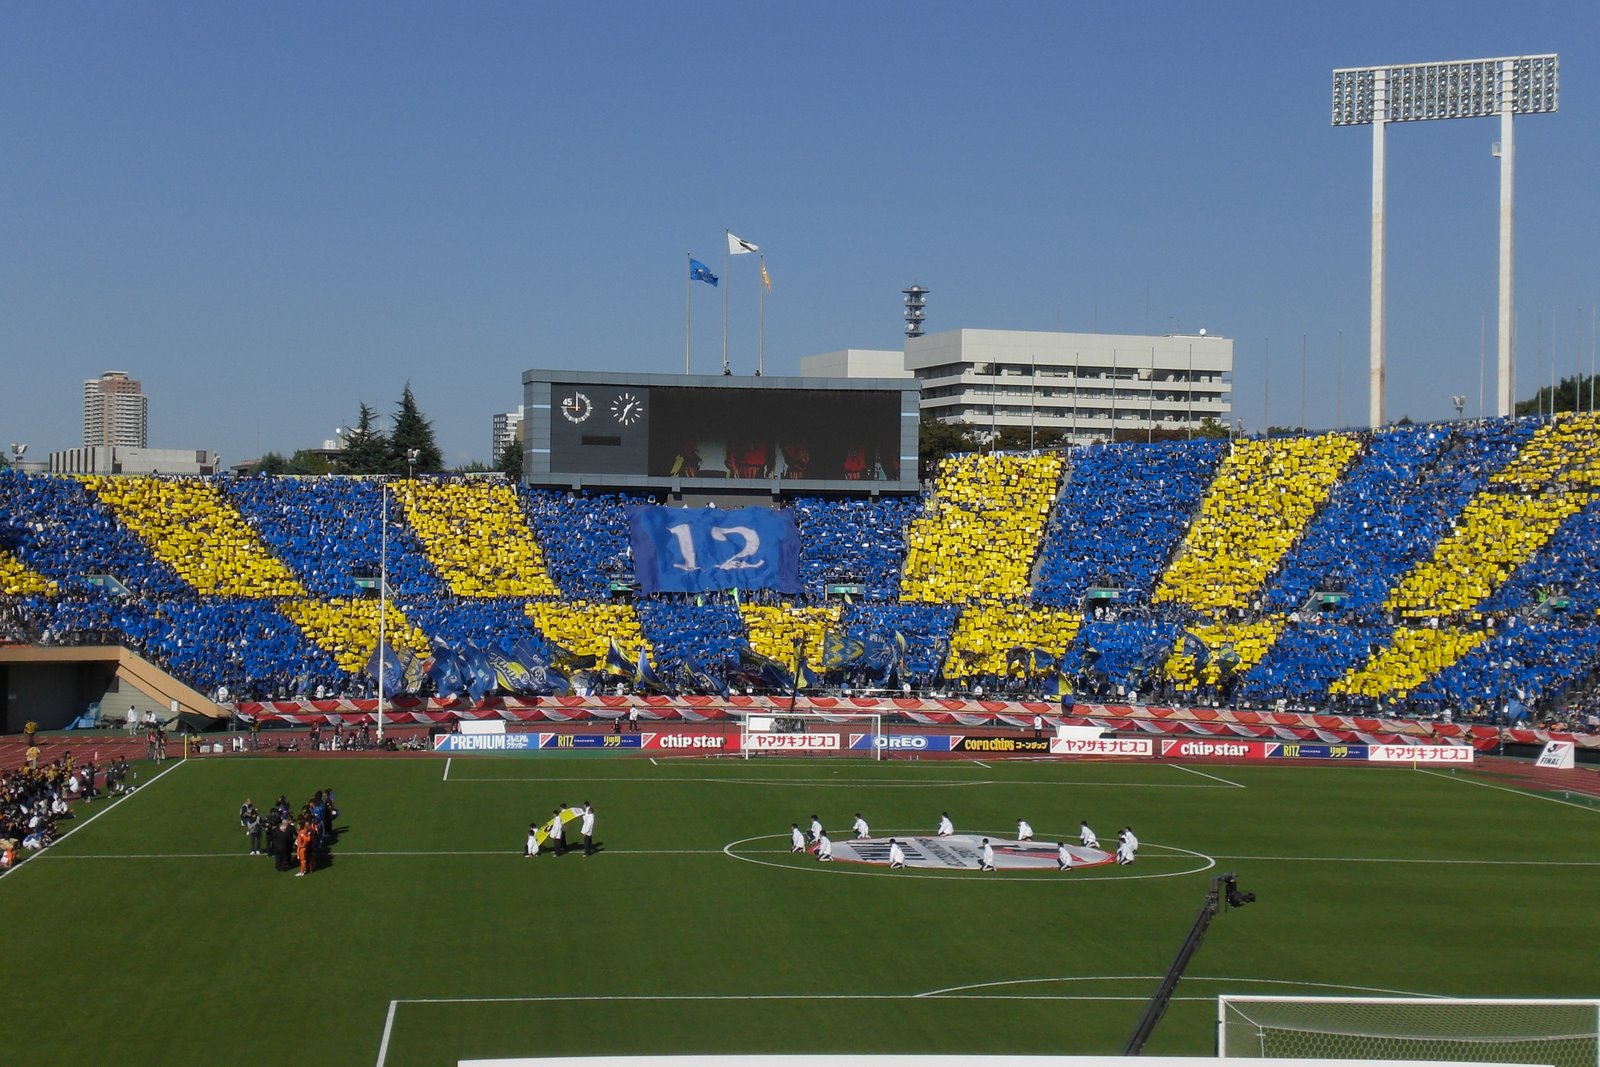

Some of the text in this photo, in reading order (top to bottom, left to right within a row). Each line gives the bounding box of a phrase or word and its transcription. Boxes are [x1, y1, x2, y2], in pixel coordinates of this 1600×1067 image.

[562, 398, 573, 406] 45
[667, 524, 765, 571] 12
[450, 735, 505, 750] PREMIUM
[557, 735, 574, 747] RITZ
[660, 734, 725, 749] chip star
[874, 737, 926, 748] OREO
[1180, 742, 1250, 757] chip star
[1283, 745, 1301, 757] RITZ
[1540, 757, 1560, 766] FINAL
